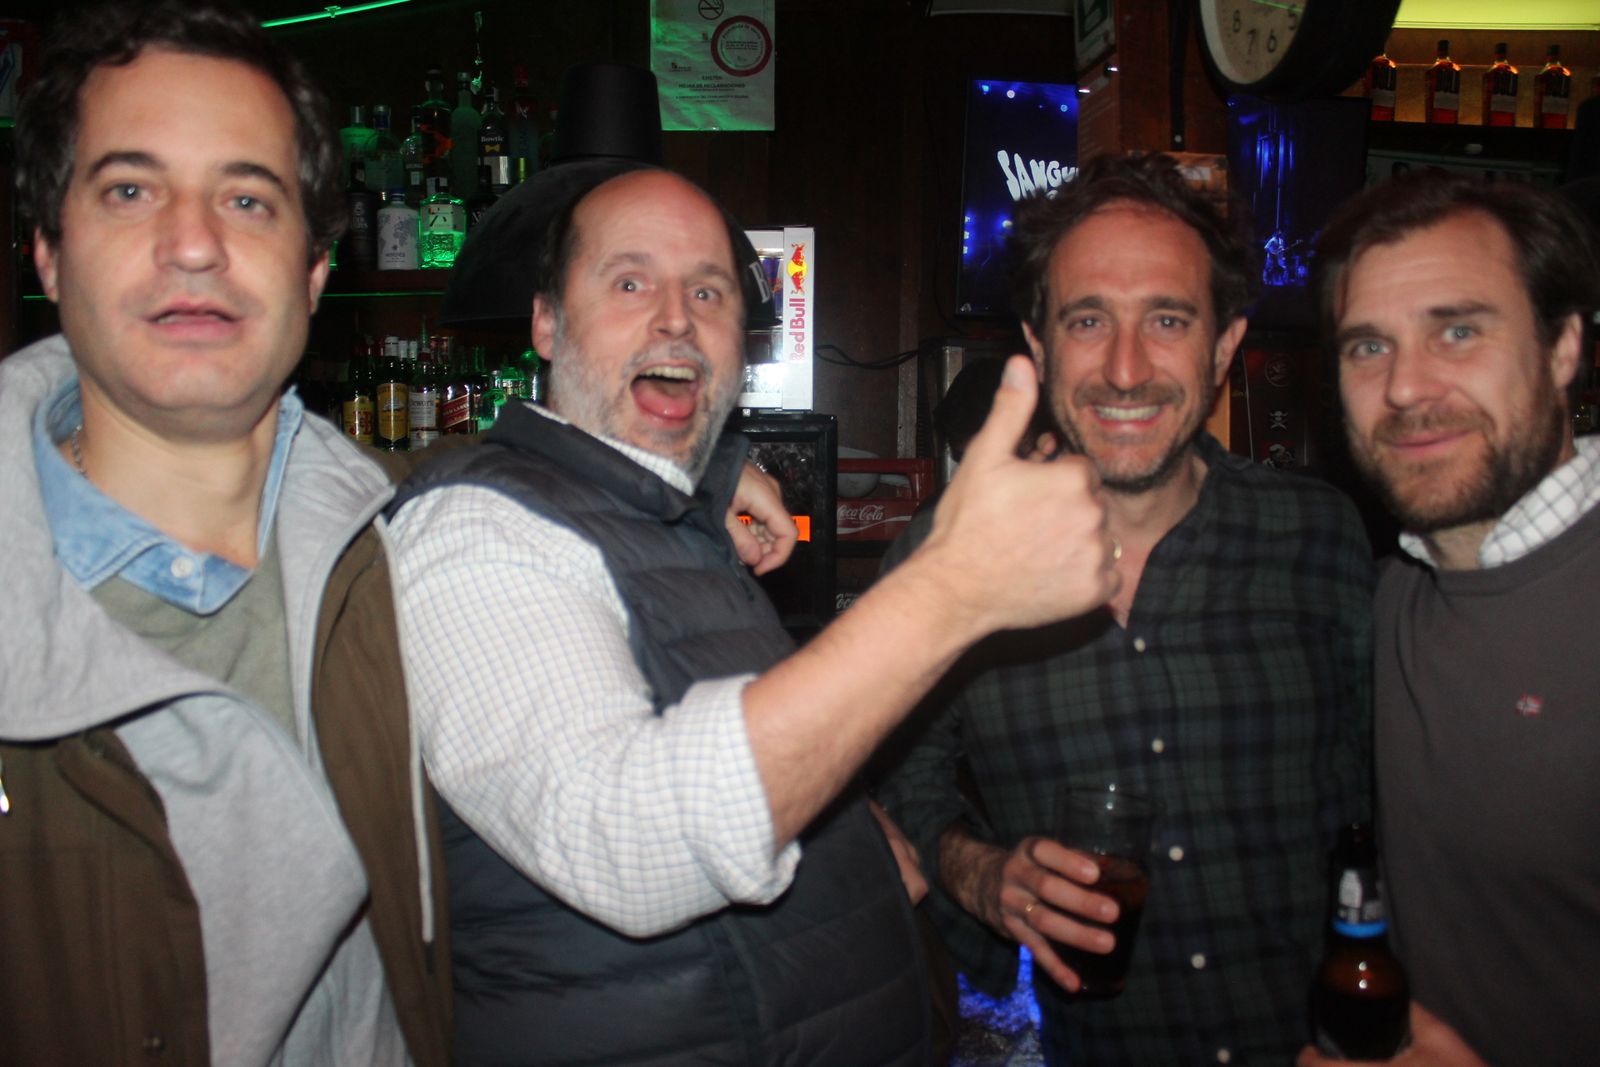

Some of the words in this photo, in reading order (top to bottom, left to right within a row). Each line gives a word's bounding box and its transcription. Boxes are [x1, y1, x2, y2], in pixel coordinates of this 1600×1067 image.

[1232, 9, 1241, 33] 8
[1247, 28, 1257, 55] 7
[1266, 29, 1277, 54] 6
[790, 298, 805, 329] Bull
[790, 331, 806, 361] Red
